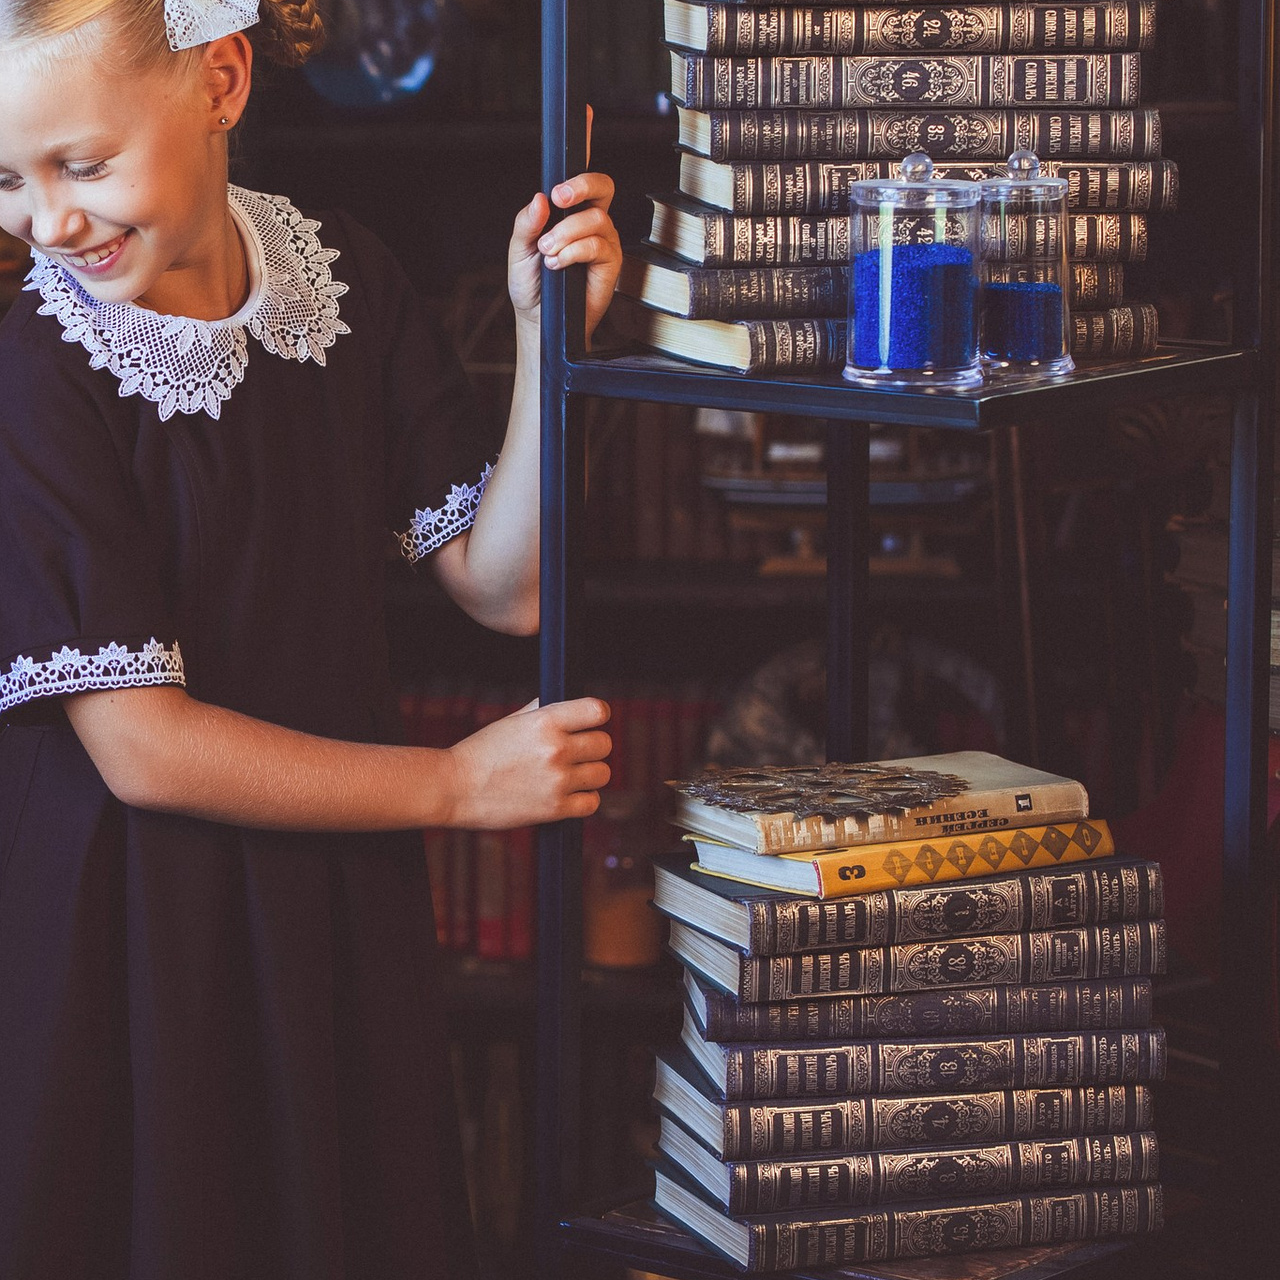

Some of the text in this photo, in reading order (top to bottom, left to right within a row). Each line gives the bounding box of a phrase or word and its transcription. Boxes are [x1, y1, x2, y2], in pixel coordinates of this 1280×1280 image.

[814, 25, 821, 36] до
[923, 19, 941, 38] 24.
[1044, 10, 1057, 47] СЛОВАРЬ
[736, 66, 746, 105] ЕФРОНЪ.
[746, 58, 757, 108] БРОКГАУЗЪ
[901, 70, 920, 90] 46.
[1025, 62, 1038, 100] СЛОВАРЬ
[1045, 60, 1058, 100] ДИЧЕСКІЙ
[927, 124, 945, 143] 35.
[1049, 116, 1062, 153] СЛОВАРЬ
[1068, 170, 1081, 208] СЛОВАРЬ
[755, 223, 766, 261] ЕФРОНЪ.
[764, 217, 776, 264] БРОКГАУЗЪ
[1035, 219, 1045, 256] СЛОВАРЬ
[913, 809, 990, 827] ЕСЕНИН
[942, 818, 1009, 837] СЕРГЕЙ
[838, 865, 866, 881] 3
[844, 902, 856, 940] СЛОВАРЬ
[948, 954, 966, 972] 48.
[1102, 927, 1111, 975] БРОКГАУЗЪ
[1111, 931, 1121, 967] ЕФРОНЪ.
[838, 952, 850, 988] СЛОВАРЬ
[825, 1054, 837, 1091] СЛОВАРЬ
[821, 1111, 832, 1147] СЛОВАРЬ
[931, 1115, 949, 1129] 4.
[1037, 1101, 1046, 1128] Ауто
[1051, 1098, 1061, 1129] Банки
